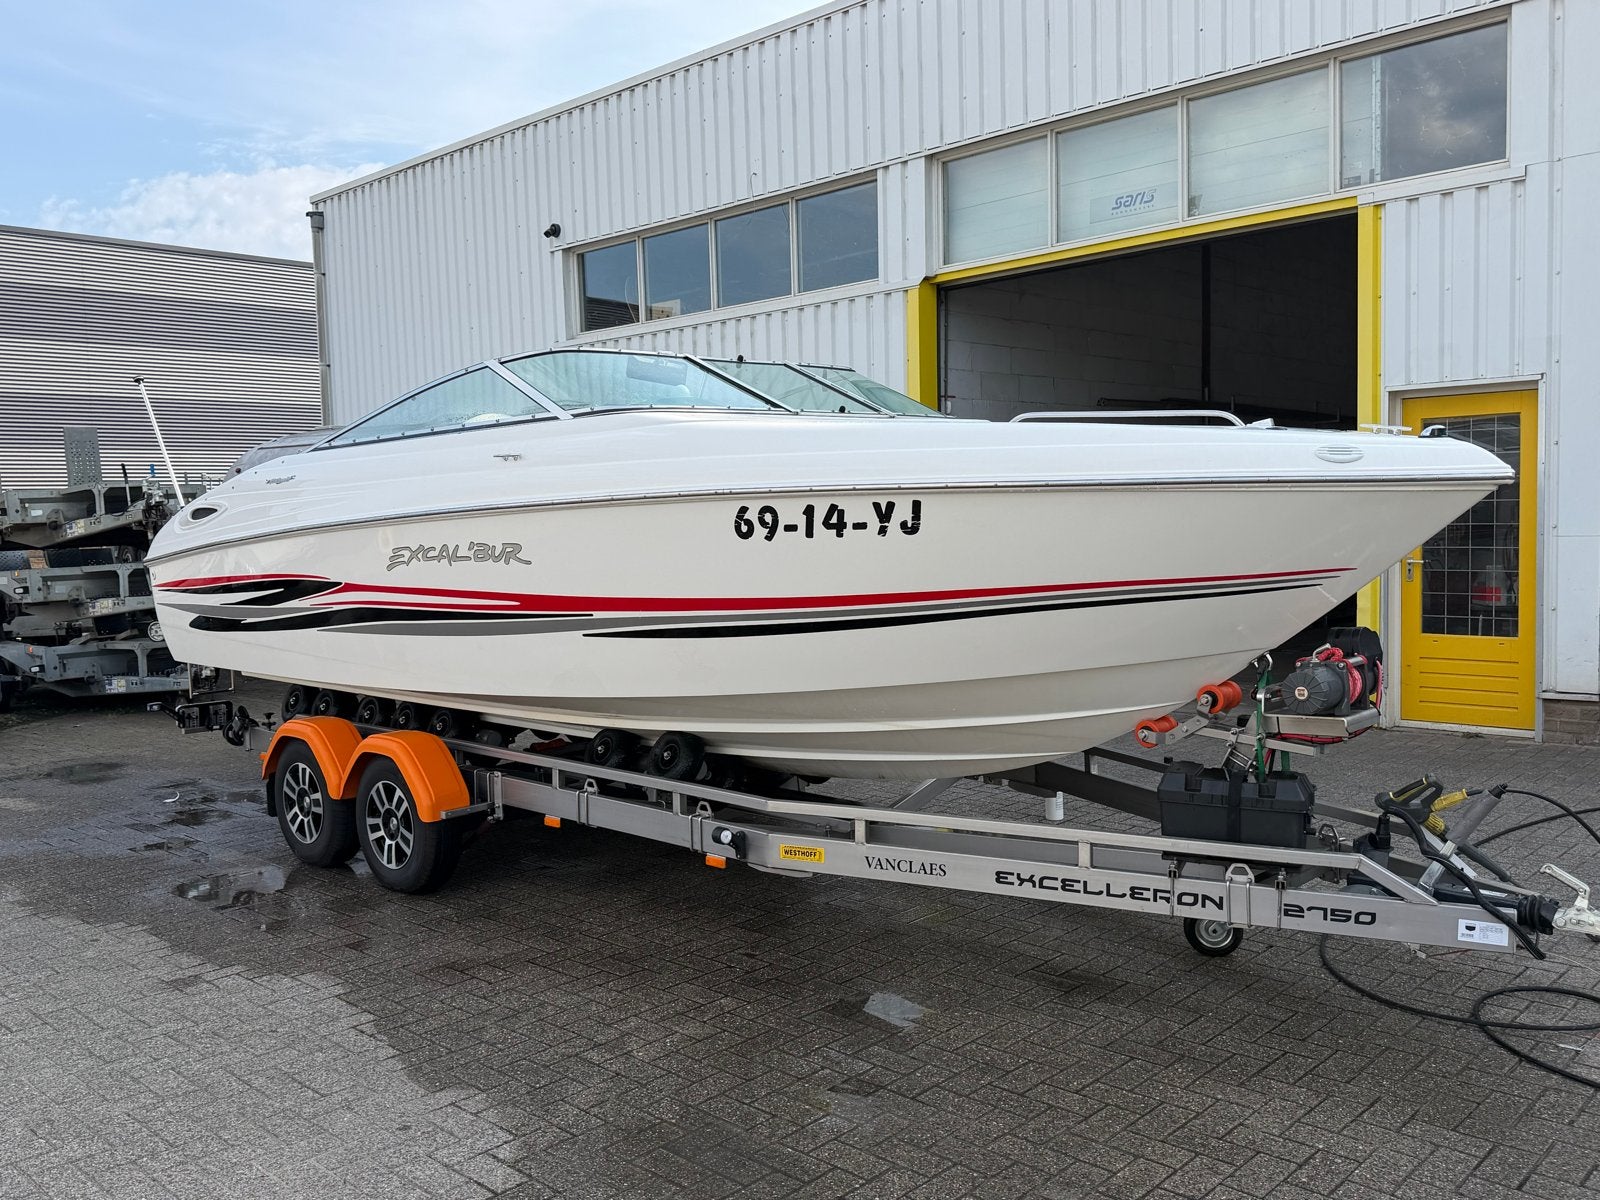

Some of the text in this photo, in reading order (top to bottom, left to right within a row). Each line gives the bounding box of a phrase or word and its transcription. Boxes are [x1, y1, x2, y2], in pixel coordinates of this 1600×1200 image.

[1111, 188, 1157, 211] saris
[783, 848, 818, 858] WESTHOFF
[864, 856, 947, 877] VANCLAES
[994, 870, 1224, 911] EXCELLERON
[1283, 903, 1376, 926] 2750
